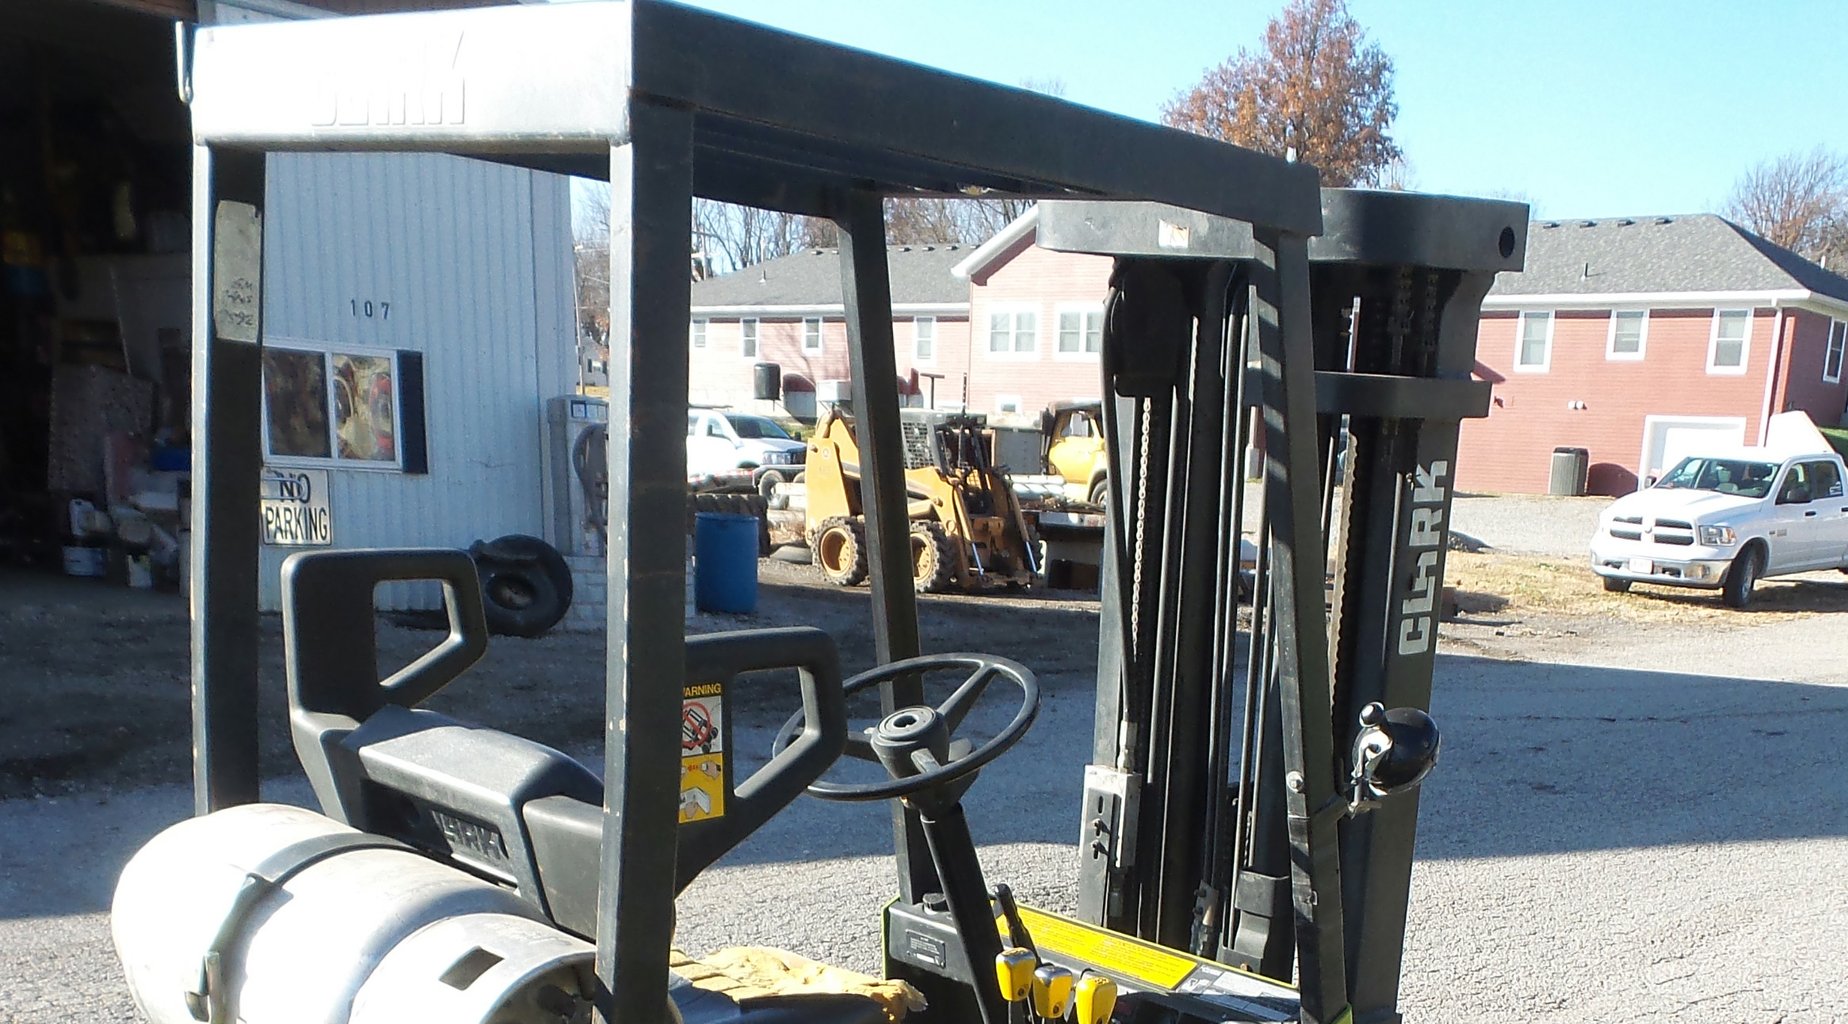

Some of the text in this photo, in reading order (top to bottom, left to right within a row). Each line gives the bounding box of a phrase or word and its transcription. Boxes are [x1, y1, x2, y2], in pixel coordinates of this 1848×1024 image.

[350, 299, 390, 320] 107
[279, 473, 311, 504] NO
[265, 506, 328, 541] PARKING
[1399, 460, 1448, 655] CLARK
[683, 683, 721, 698] ARNING
